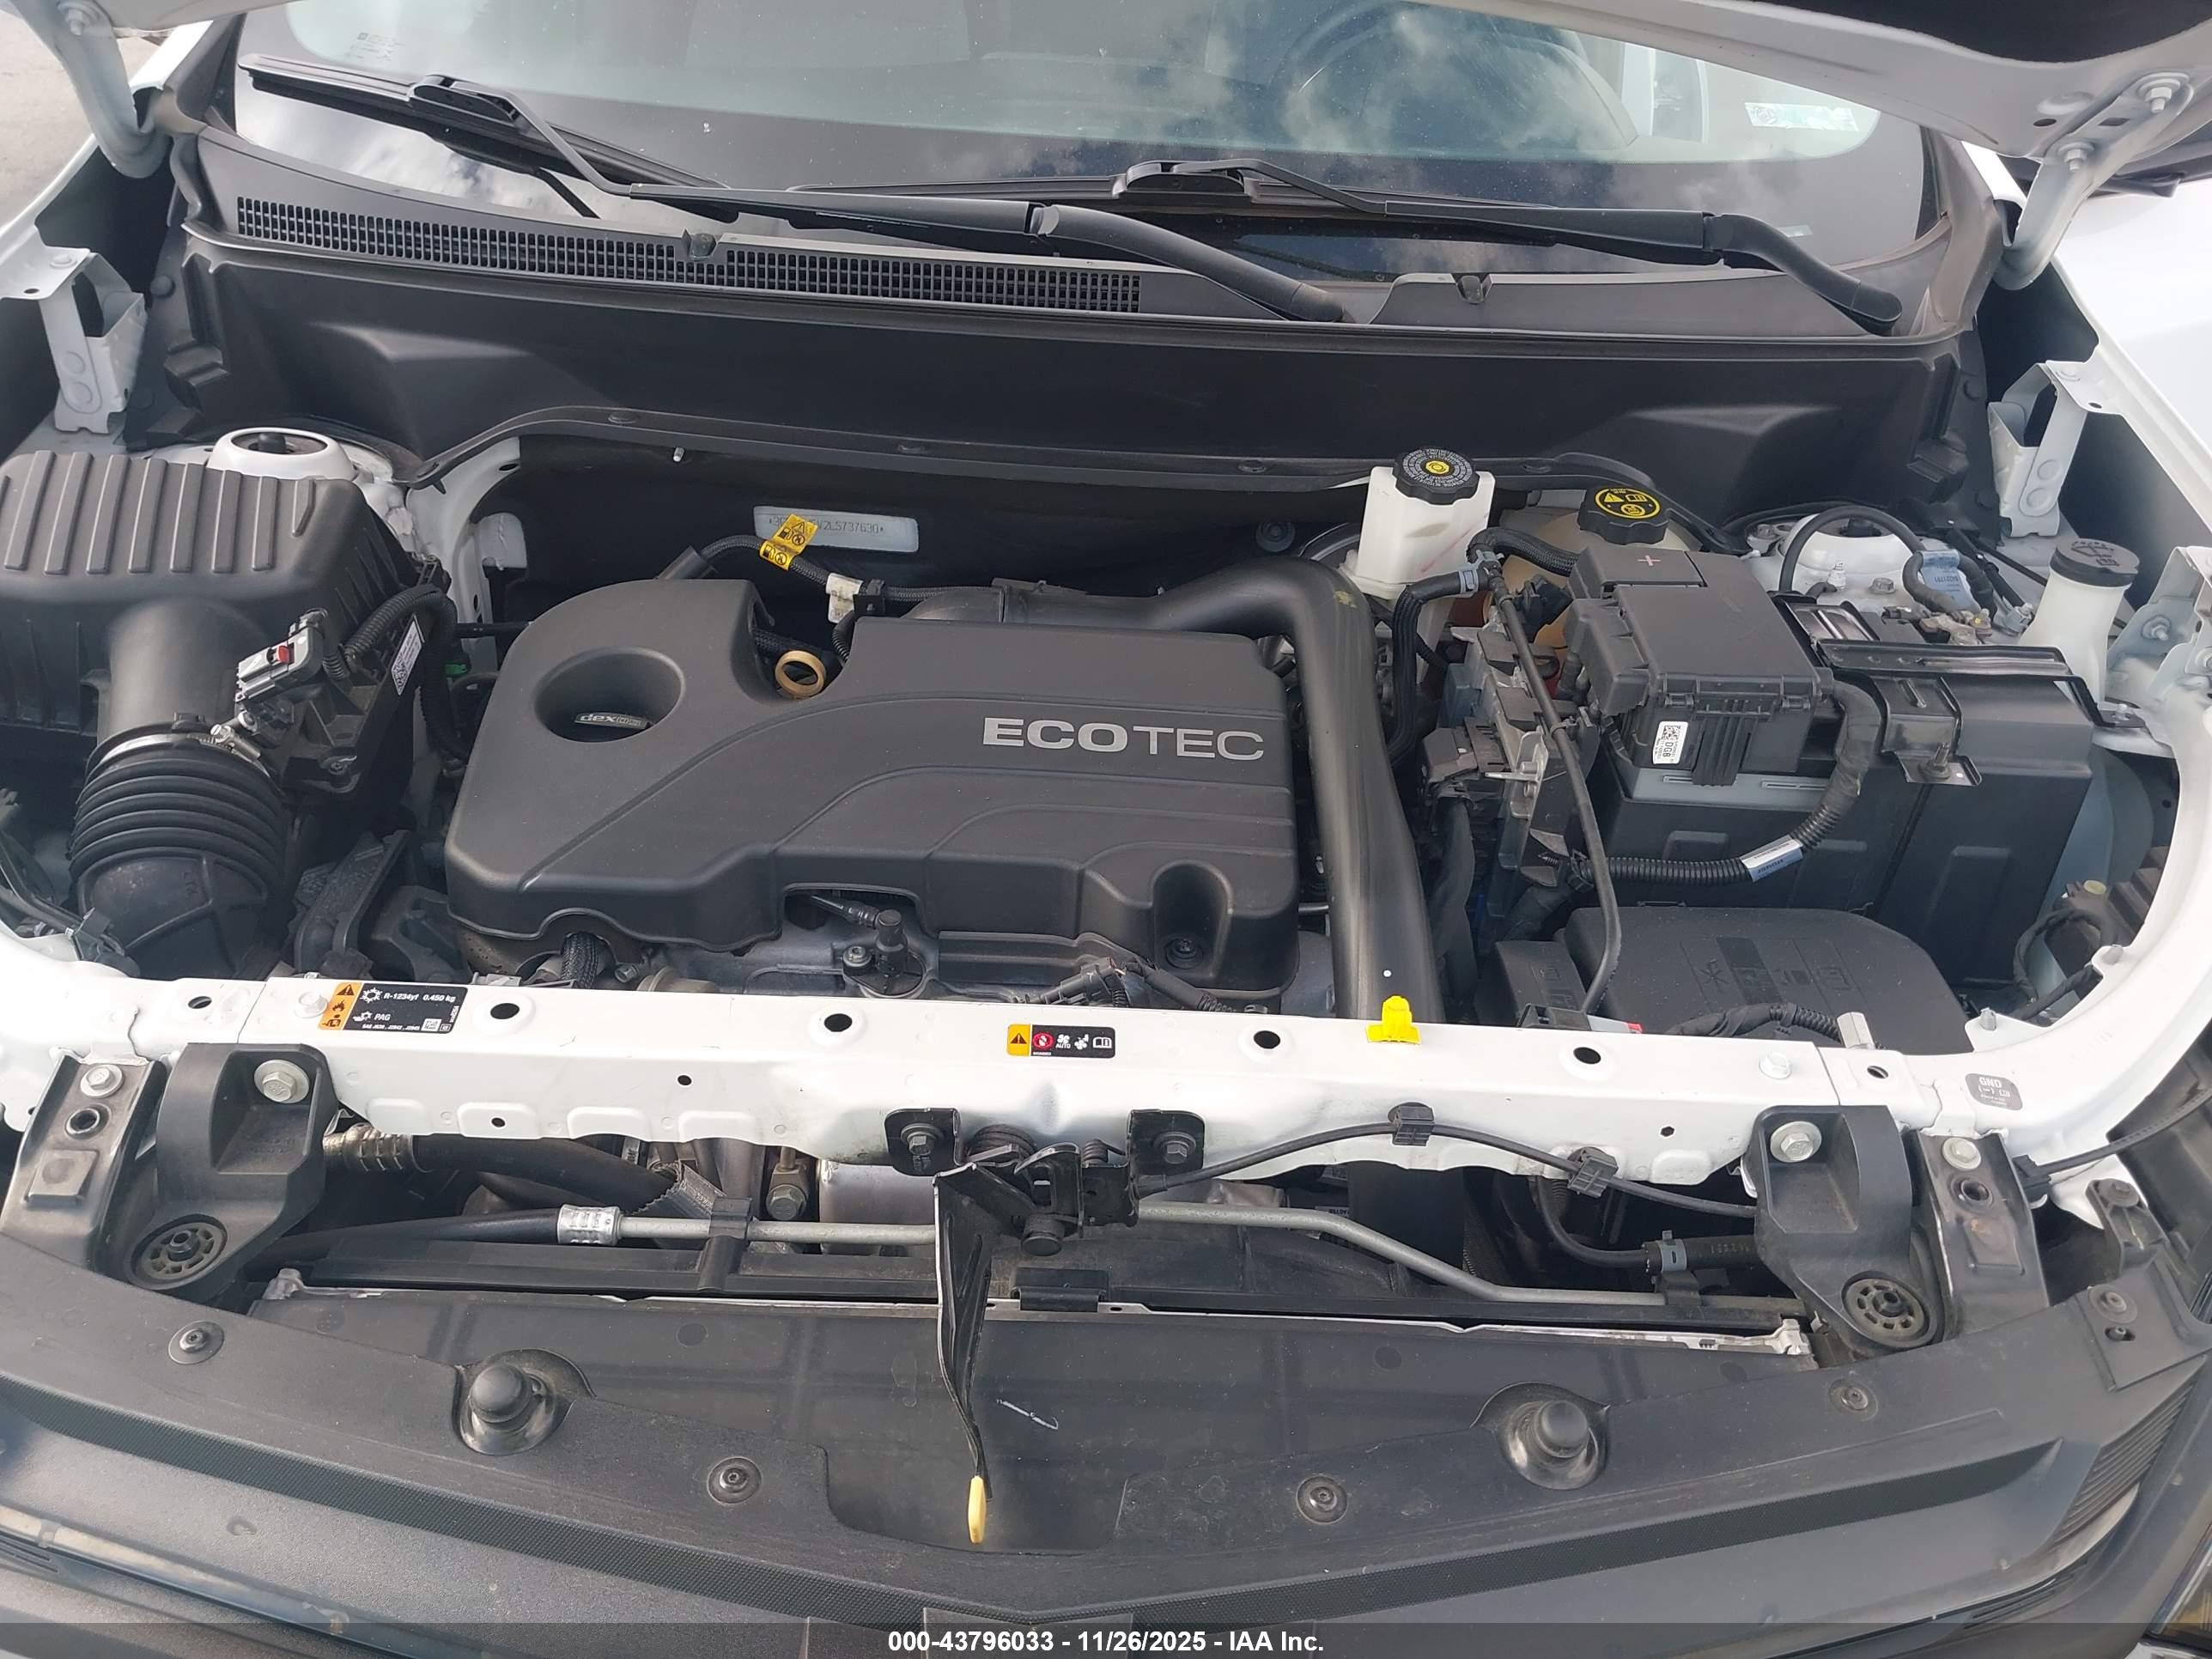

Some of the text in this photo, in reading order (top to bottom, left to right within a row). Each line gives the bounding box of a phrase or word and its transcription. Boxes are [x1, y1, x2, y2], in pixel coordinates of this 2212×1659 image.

[982, 717, 1265, 761] ECOTEC
[383, 992, 420, 1001] R-1234yf
[1979, 1077, 2002, 1088] GND
